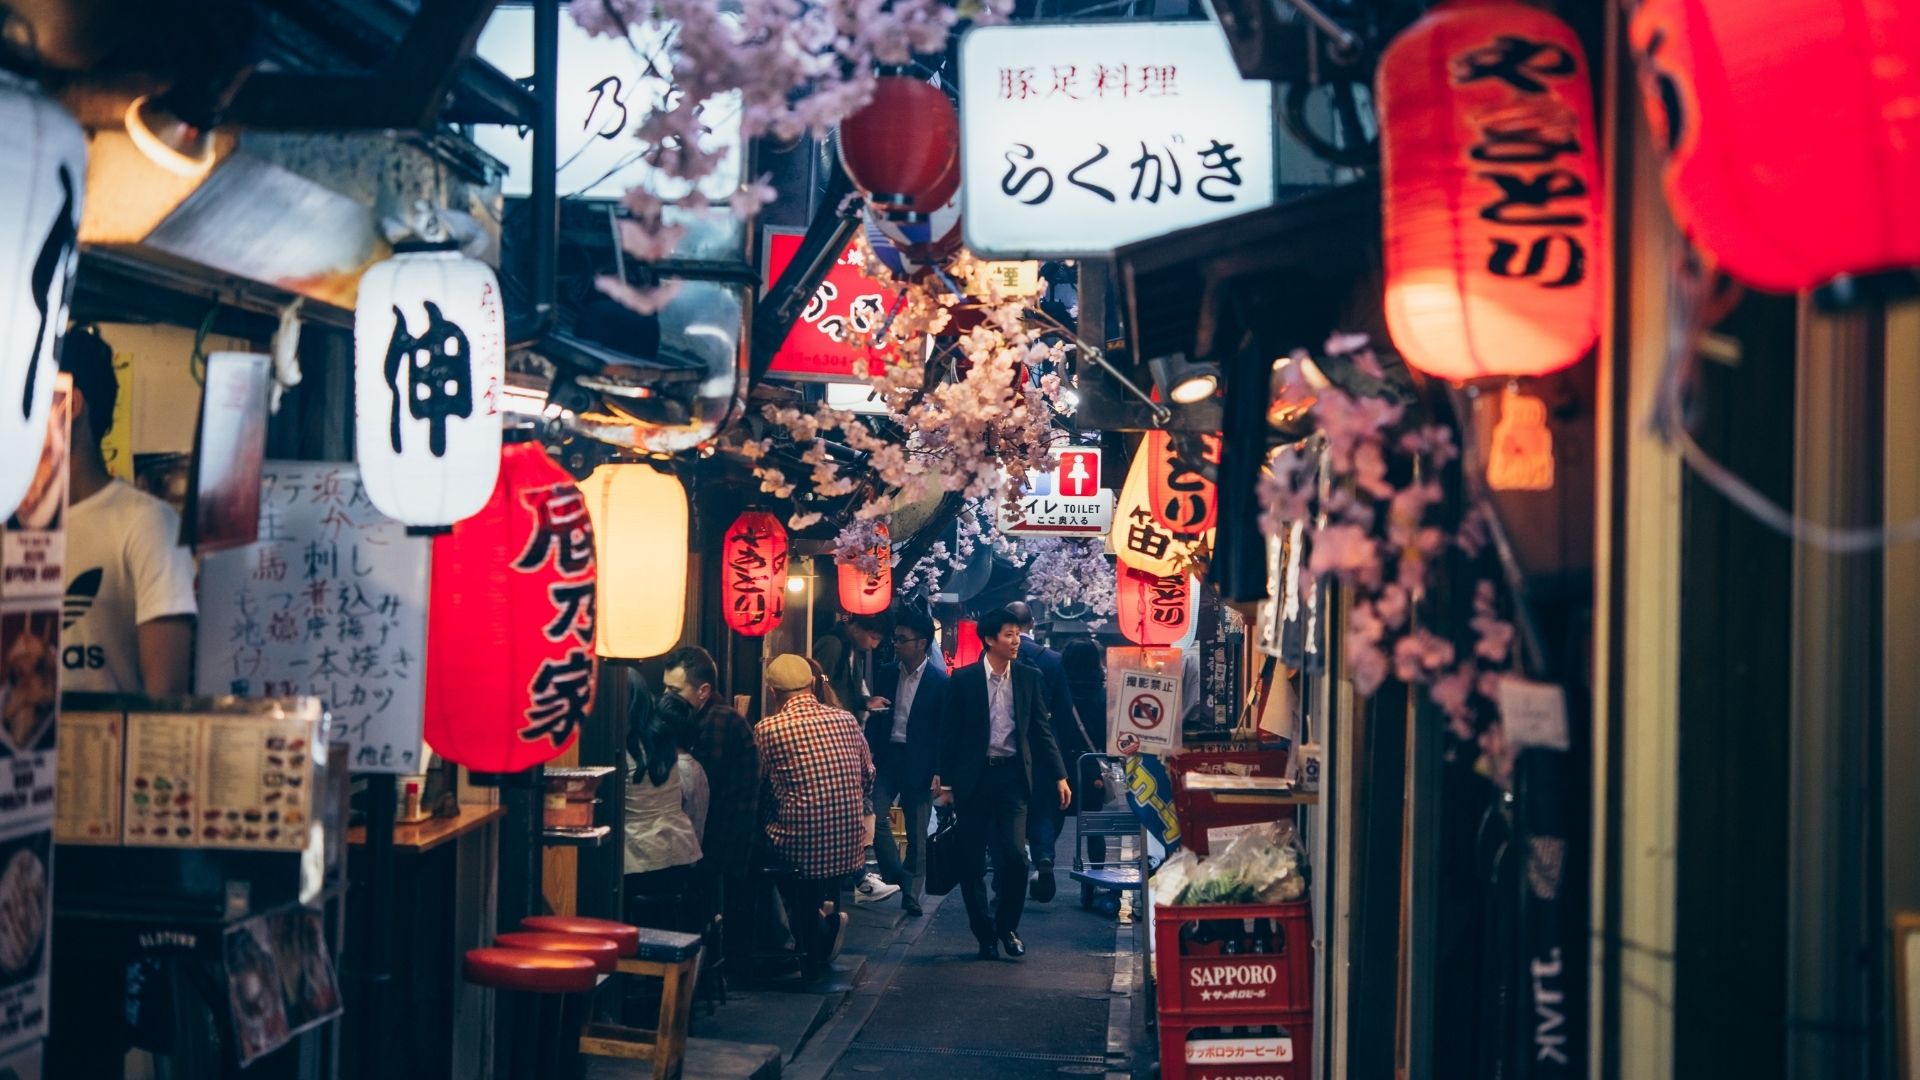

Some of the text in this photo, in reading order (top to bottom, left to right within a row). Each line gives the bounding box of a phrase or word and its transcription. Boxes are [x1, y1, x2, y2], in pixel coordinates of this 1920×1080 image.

[998, 63, 1181, 100] 豚足料理
[1001, 134, 1243, 206] らくがき
[383, 300, 473, 458] 伸
[1026, 499, 1058, 515] イレ
[1064, 504, 1101, 514] TOILET
[1037, 516, 1089, 526] ここ奥入る
[1126, 675, 1173, 693] 撮影禁止
[1190, 965, 1277, 987] SAPPORO
